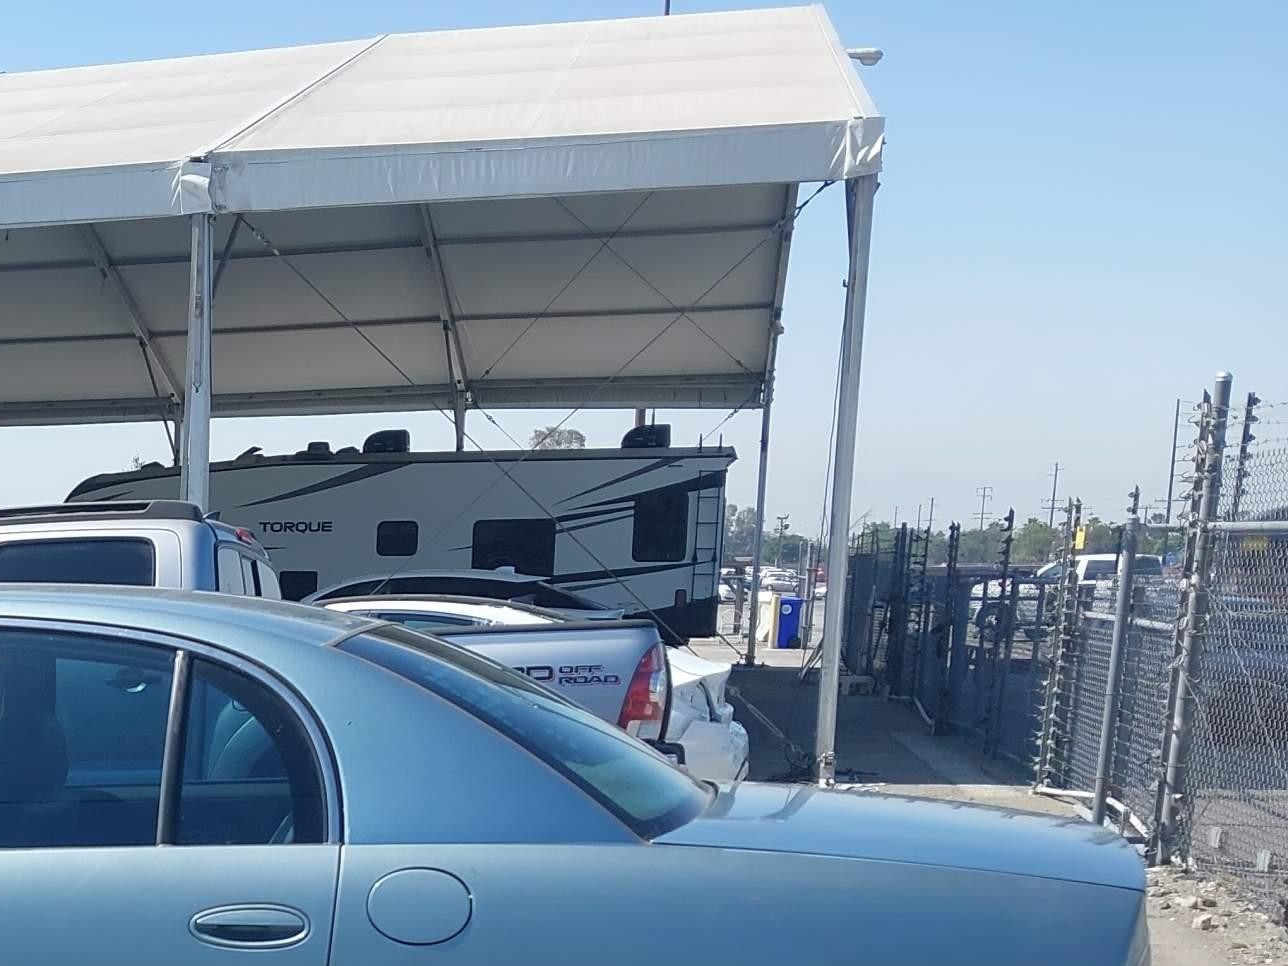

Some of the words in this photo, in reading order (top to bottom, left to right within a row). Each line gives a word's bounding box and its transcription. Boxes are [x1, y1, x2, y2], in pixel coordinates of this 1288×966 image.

[259, 521, 333, 534] TORQUE
[558, 664, 605, 675] OFF
[558, 675, 621, 686] ROAD
